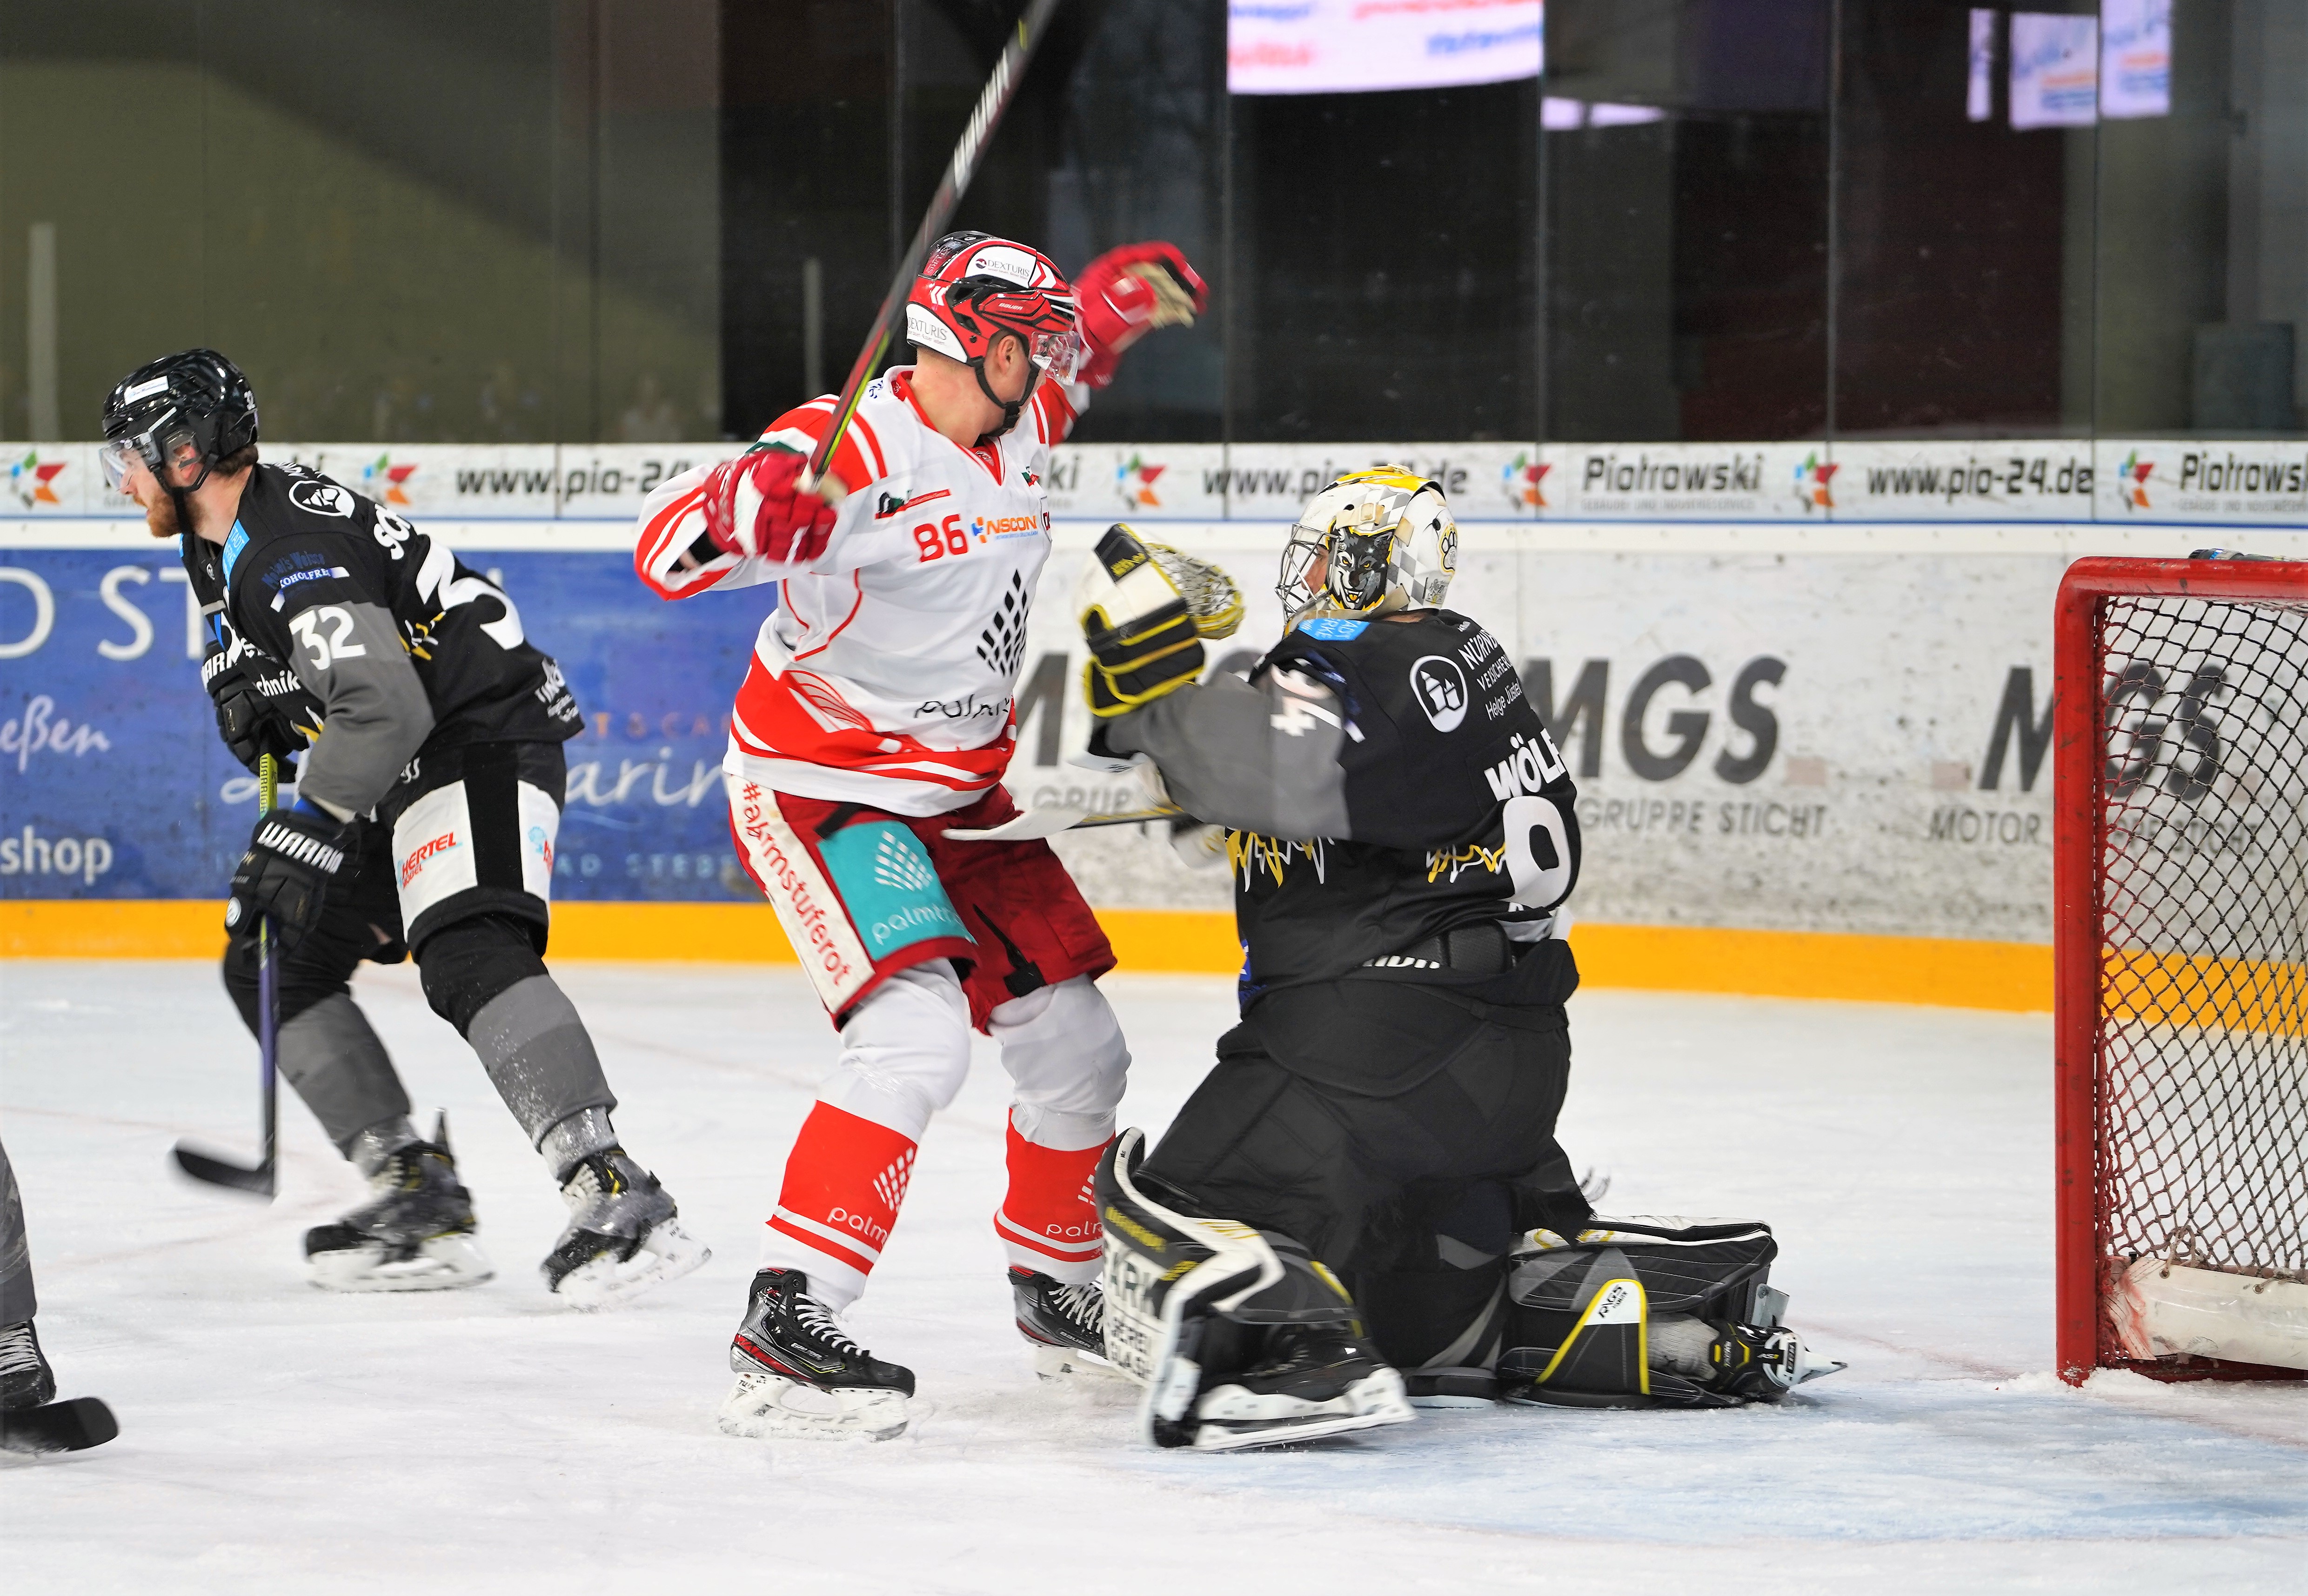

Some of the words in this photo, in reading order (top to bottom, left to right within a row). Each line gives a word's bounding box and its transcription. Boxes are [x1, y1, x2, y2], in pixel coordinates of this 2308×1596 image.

[988, 260, 1030, 277] DEXTURIS
[908, 317, 947, 340] DEXTURIS
[1583, 453, 1764, 491] Piotrowski
[2180, 451, 2308, 493] Piotrows
[913, 514, 970, 562] 86
[289, 606, 367, 671] 32
[1476, 654, 1512, 692] VERSICHER
[1719, 800, 1828, 837] STICHT
[1929, 808, 2041, 843] MOTOR
[1, 825, 114, 886] shop
[401, 831, 457, 880] HERTEL
